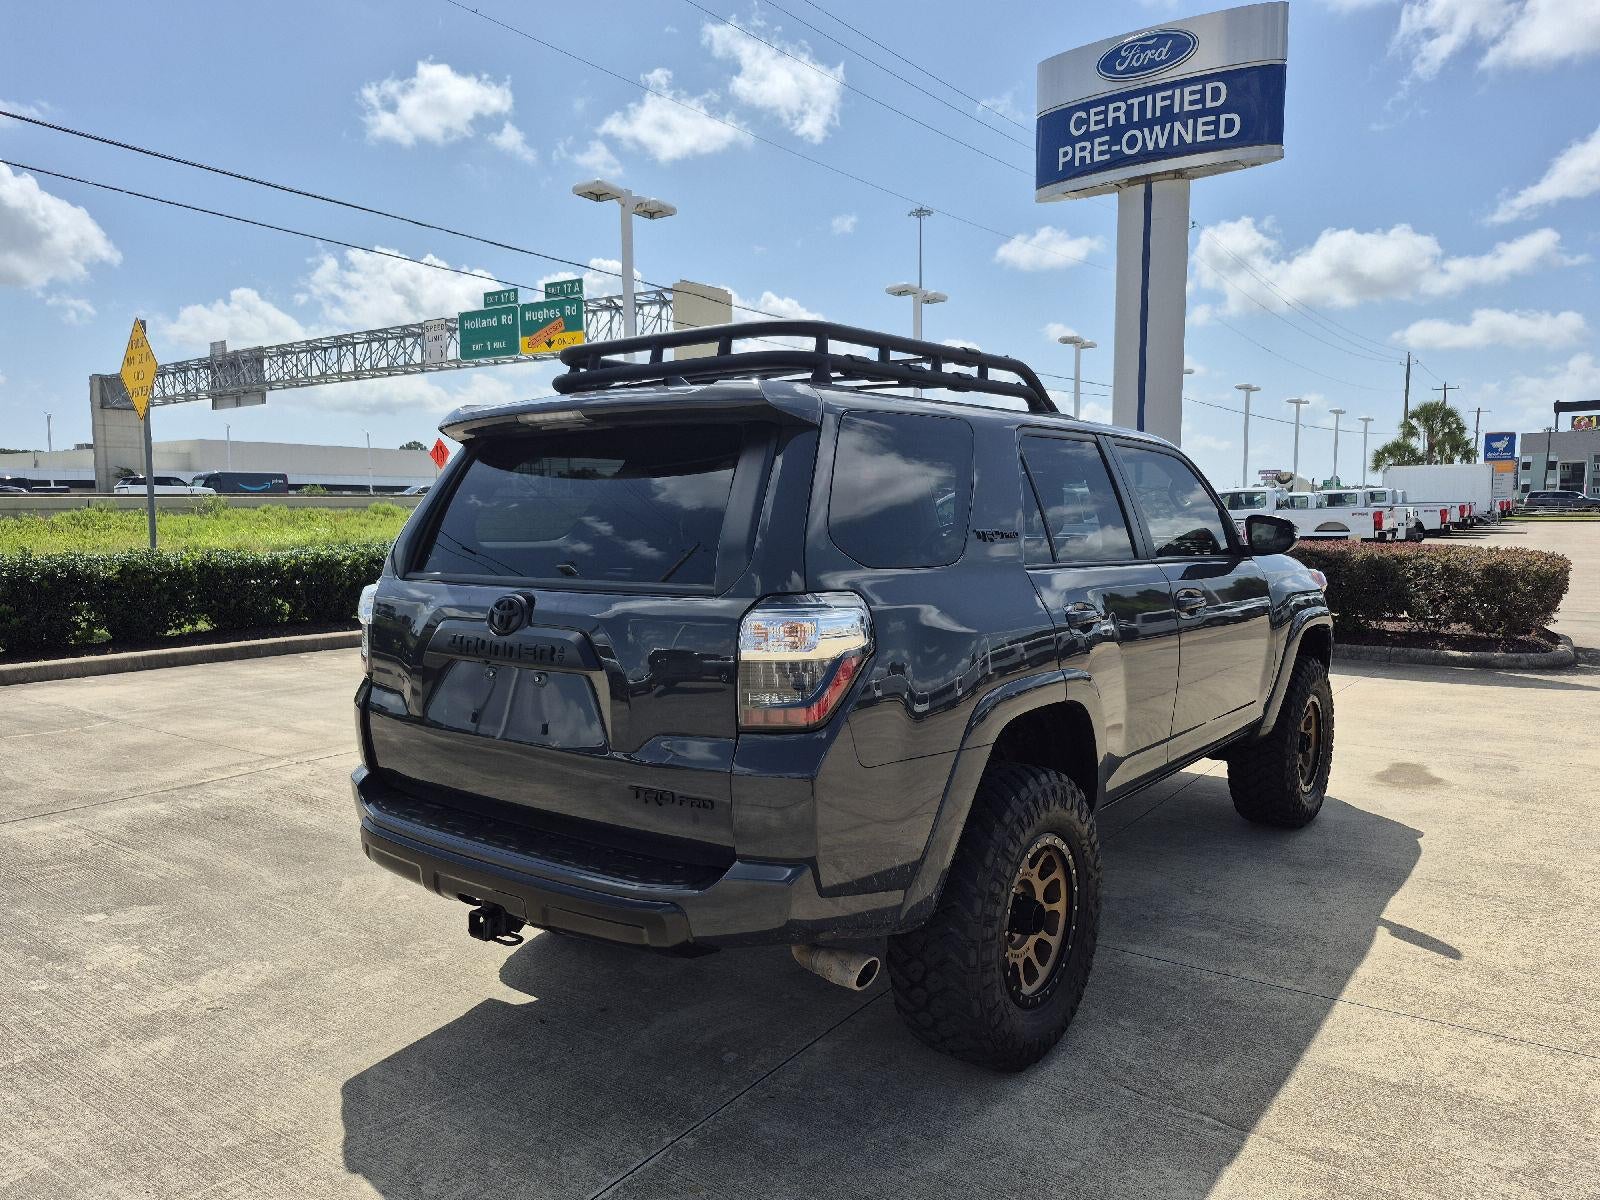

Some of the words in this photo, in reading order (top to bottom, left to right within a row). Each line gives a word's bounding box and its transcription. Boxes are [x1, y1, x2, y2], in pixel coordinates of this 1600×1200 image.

[1115, 37, 1172, 72] Ford
[1069, 81, 1227, 137] CERTIFIED
[1057, 113, 1241, 171] PRE-OWNED
[563, 283, 572, 293] 17
[573, 282, 580, 292] A
[486, 295, 498, 303] EXIT
[501, 292, 509, 302] 17
[525, 307, 561, 322] Hughes
[565, 304, 577, 316] Rd
[464, 315, 498, 330] Holland
[501, 313, 513, 325] Rd
[425, 323, 445, 332] SPEED
[428, 334, 443, 343] LIMIT
[557, 337, 576, 346] ONLY
[486, 341, 491, 350] 1
